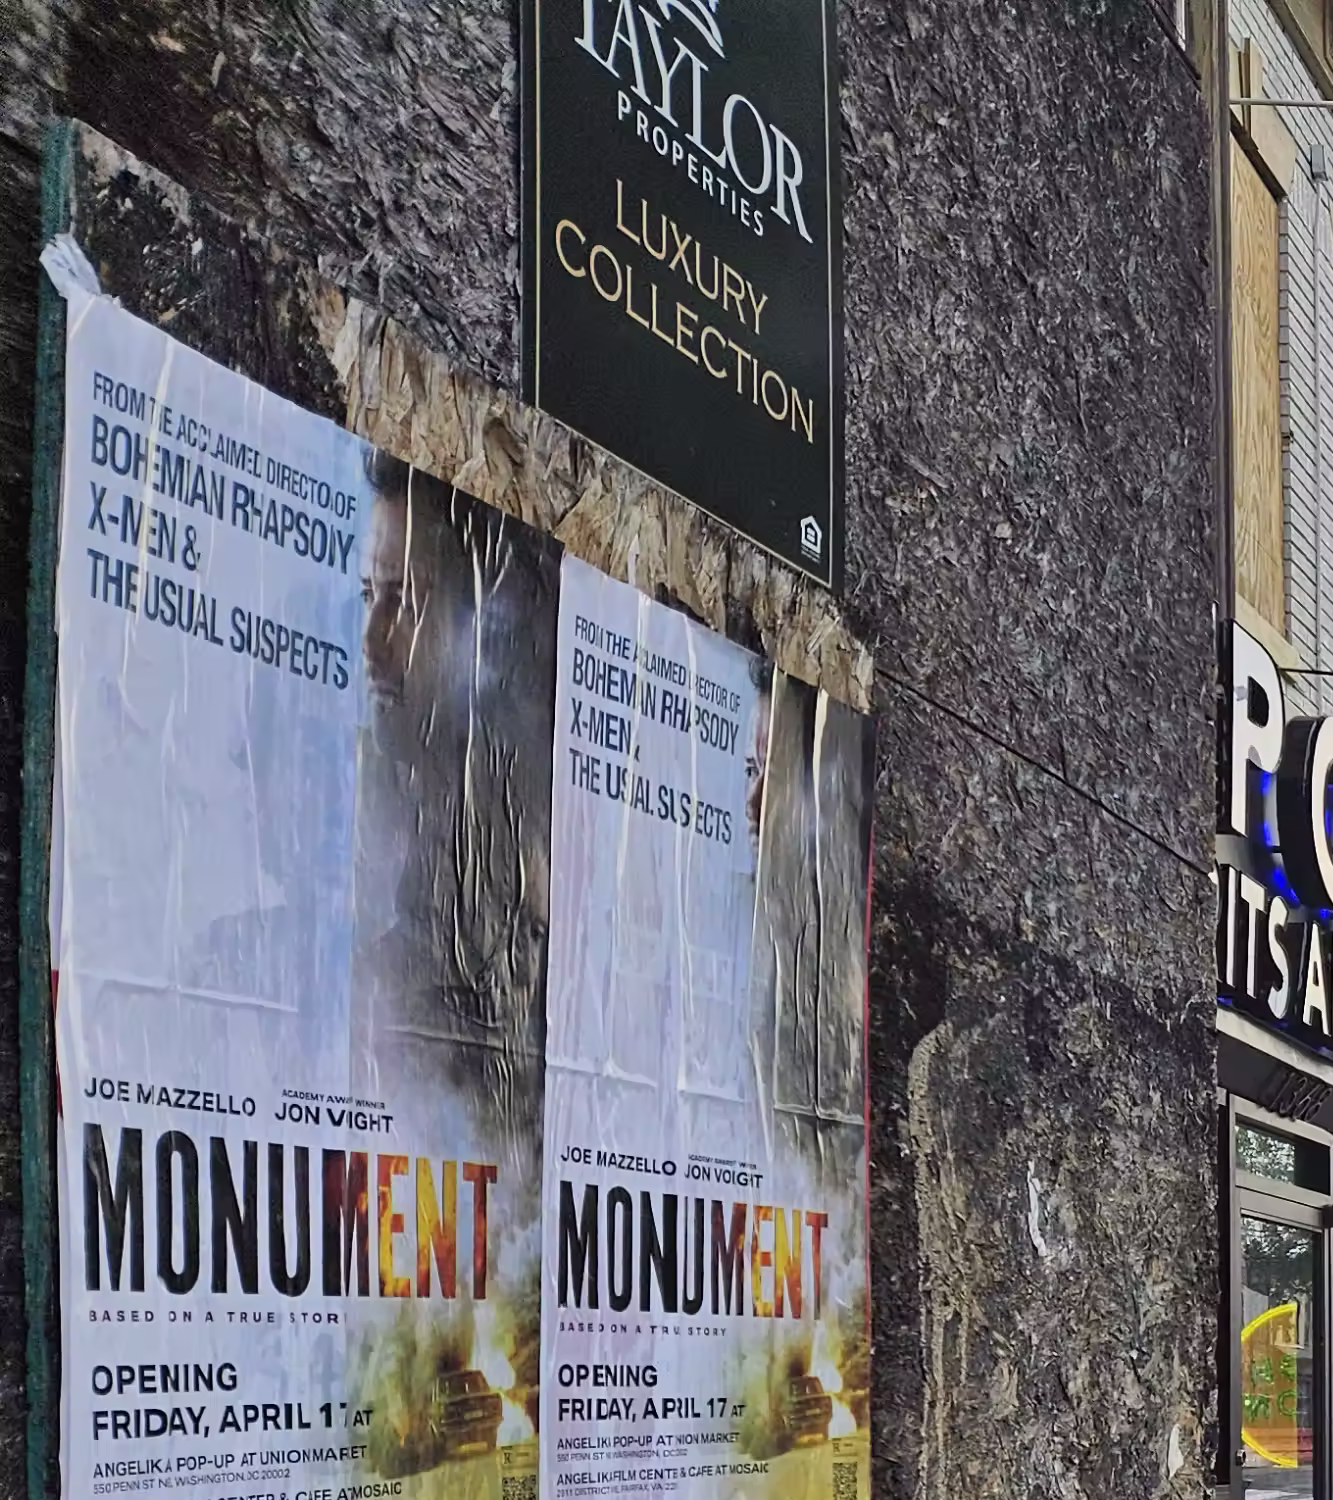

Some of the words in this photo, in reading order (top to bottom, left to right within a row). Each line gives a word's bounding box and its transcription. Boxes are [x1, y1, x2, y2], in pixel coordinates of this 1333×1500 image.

[574, 0, 813, 243] TAYLOR
[617, 90, 765, 237] PROPERTIES
[616, 177, 768, 335] LUXURY
[555, 219, 815, 444] COLLECTION
[94, 370, 146, 421] FROM
[91, 414, 225, 521] BOHEMIAN
[87, 548, 138, 613] THE
[144, 570, 223, 647] USUAL
[230, 606, 349, 690] SUSPECTS
[606, 631, 631, 661] THE
[570, 697, 632, 755] X-MEN
[569, 747, 601, 795] THE
[1226, 867, 1290, 1019] ITS
[84, 1077, 130, 1102] JOE
[136, 1083, 256, 1117] MAZZELLO
[274, 1102, 321, 1125] JON
[560, 1146, 592, 1165] JOE
[597, 1150, 677, 1176] MAZZELLO
[684, 1163, 711, 1181] JON
[84, 1122, 497, 1299] MONUMENT
[557, 1180, 829, 1320] MONUMENT
[89, 1310, 155, 1323] BASED
[204, 1311, 214, 1323] A
[227, 1311, 276, 1323] TRUE
[91, 1362, 238, 1396] OPENING
[558, 1364, 658, 1387] OPENING
[92, 1406, 210, 1440] FRIDAY,
[219, 1403, 311, 1434] APRIL
[353, 1410, 373, 1426] AT
[558, 1398, 637, 1423] FRIDAY,
[642, 1397, 701, 1420] APRIL
[706, 1398, 728, 1418] 17
[730, 1404, 746, 1417] AT
[613, 1435, 653, 1448] POP-UP
[93, 1458, 172, 1479] ANGELIKA
[177, 1454, 234, 1472] POP-UP
[241, 1452, 256, 1467] AT
[259, 1449, 312, 1465] UNION
